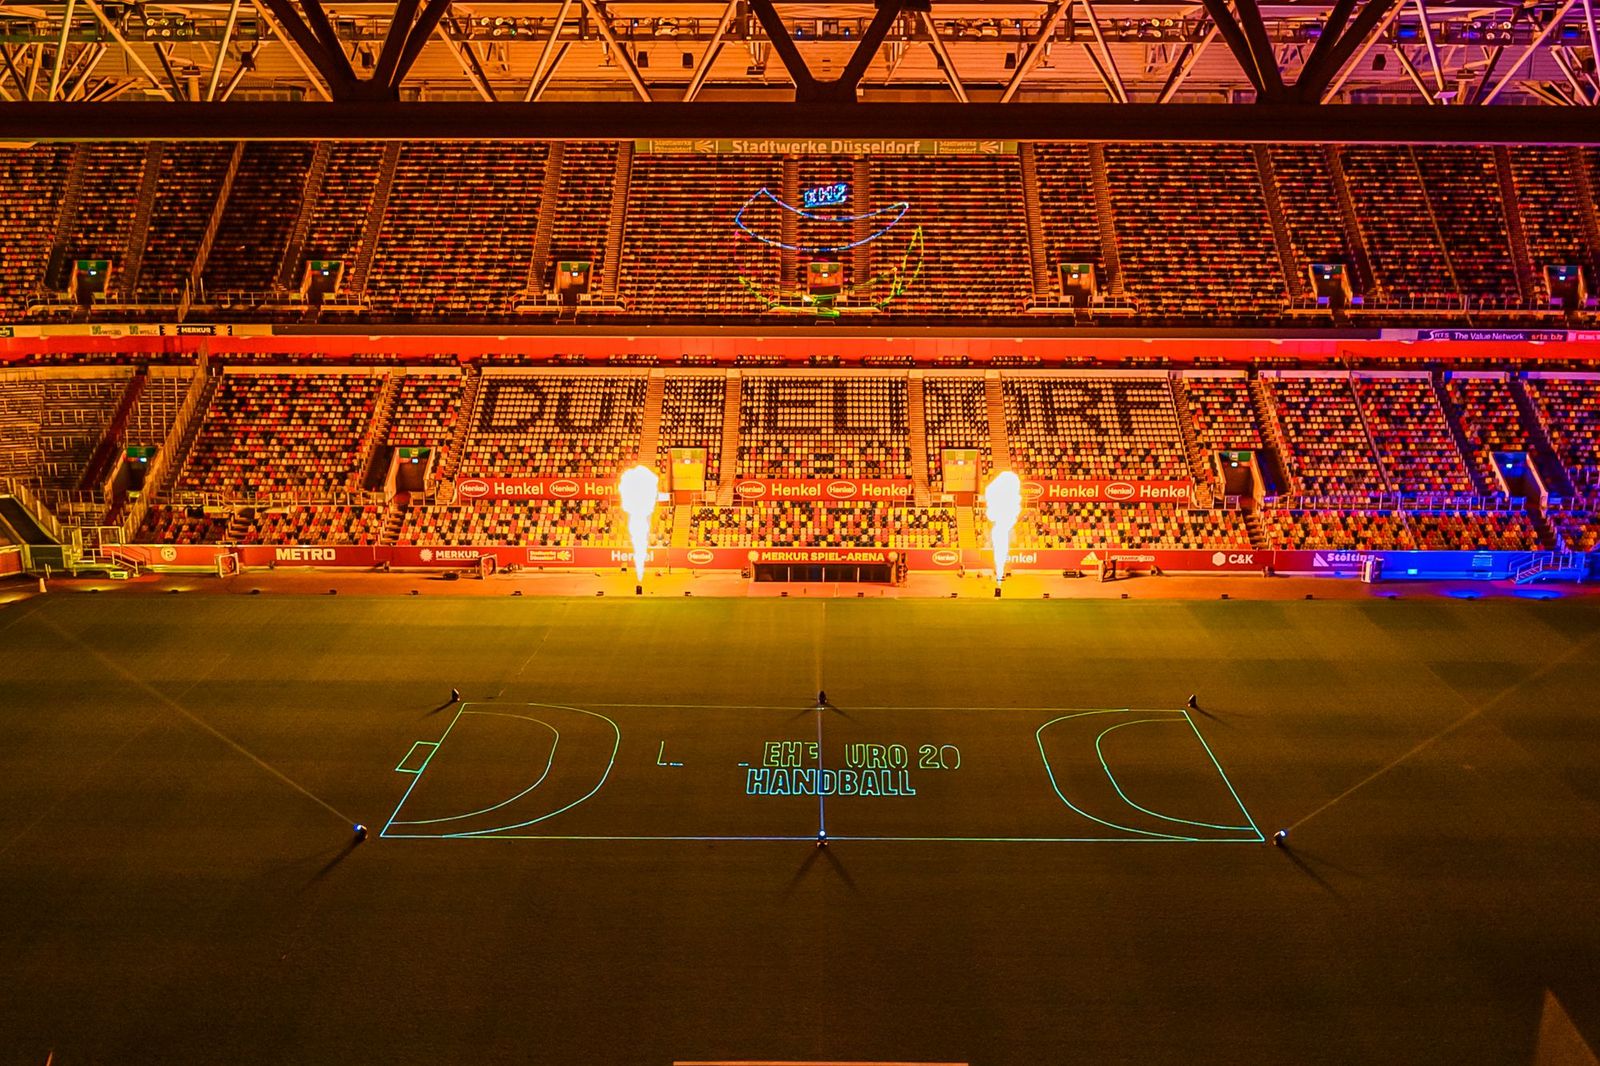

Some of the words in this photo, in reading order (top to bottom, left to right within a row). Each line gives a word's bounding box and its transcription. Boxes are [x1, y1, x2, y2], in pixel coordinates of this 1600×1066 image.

[732, 140, 827, 153] Stadtwerke
[831, 140, 920, 154] Düsseldorf
[1454, 332, 1468, 340] The
[1470, 332, 1491, 340] Value
[1492, 332, 1524, 340] Network
[461, 485, 487, 493] Henkel
[494, 483, 544, 496] Henkel
[552, 485, 577, 493] Henkel
[584, 482, 618, 496] Hen
[738, 486, 764, 494] Henkel
[771, 484, 821, 497] Henkel
[829, 486, 855, 494] Henkel
[862, 484, 912, 497] Henkel
[1049, 485, 1099, 498] Henkel
[1107, 487, 1133, 495] Henkel
[1140, 485, 1191, 498] Henkel
[276, 548, 336, 561] METRO
[435, 550, 479, 559] MERKUR
[762, 552, 808, 560] MERKUR
[811, 552, 884, 561] SPIEL-ARENA
[1228, 554, 1254, 564] C&K
[746, 768, 917, 796] HANDBALL
